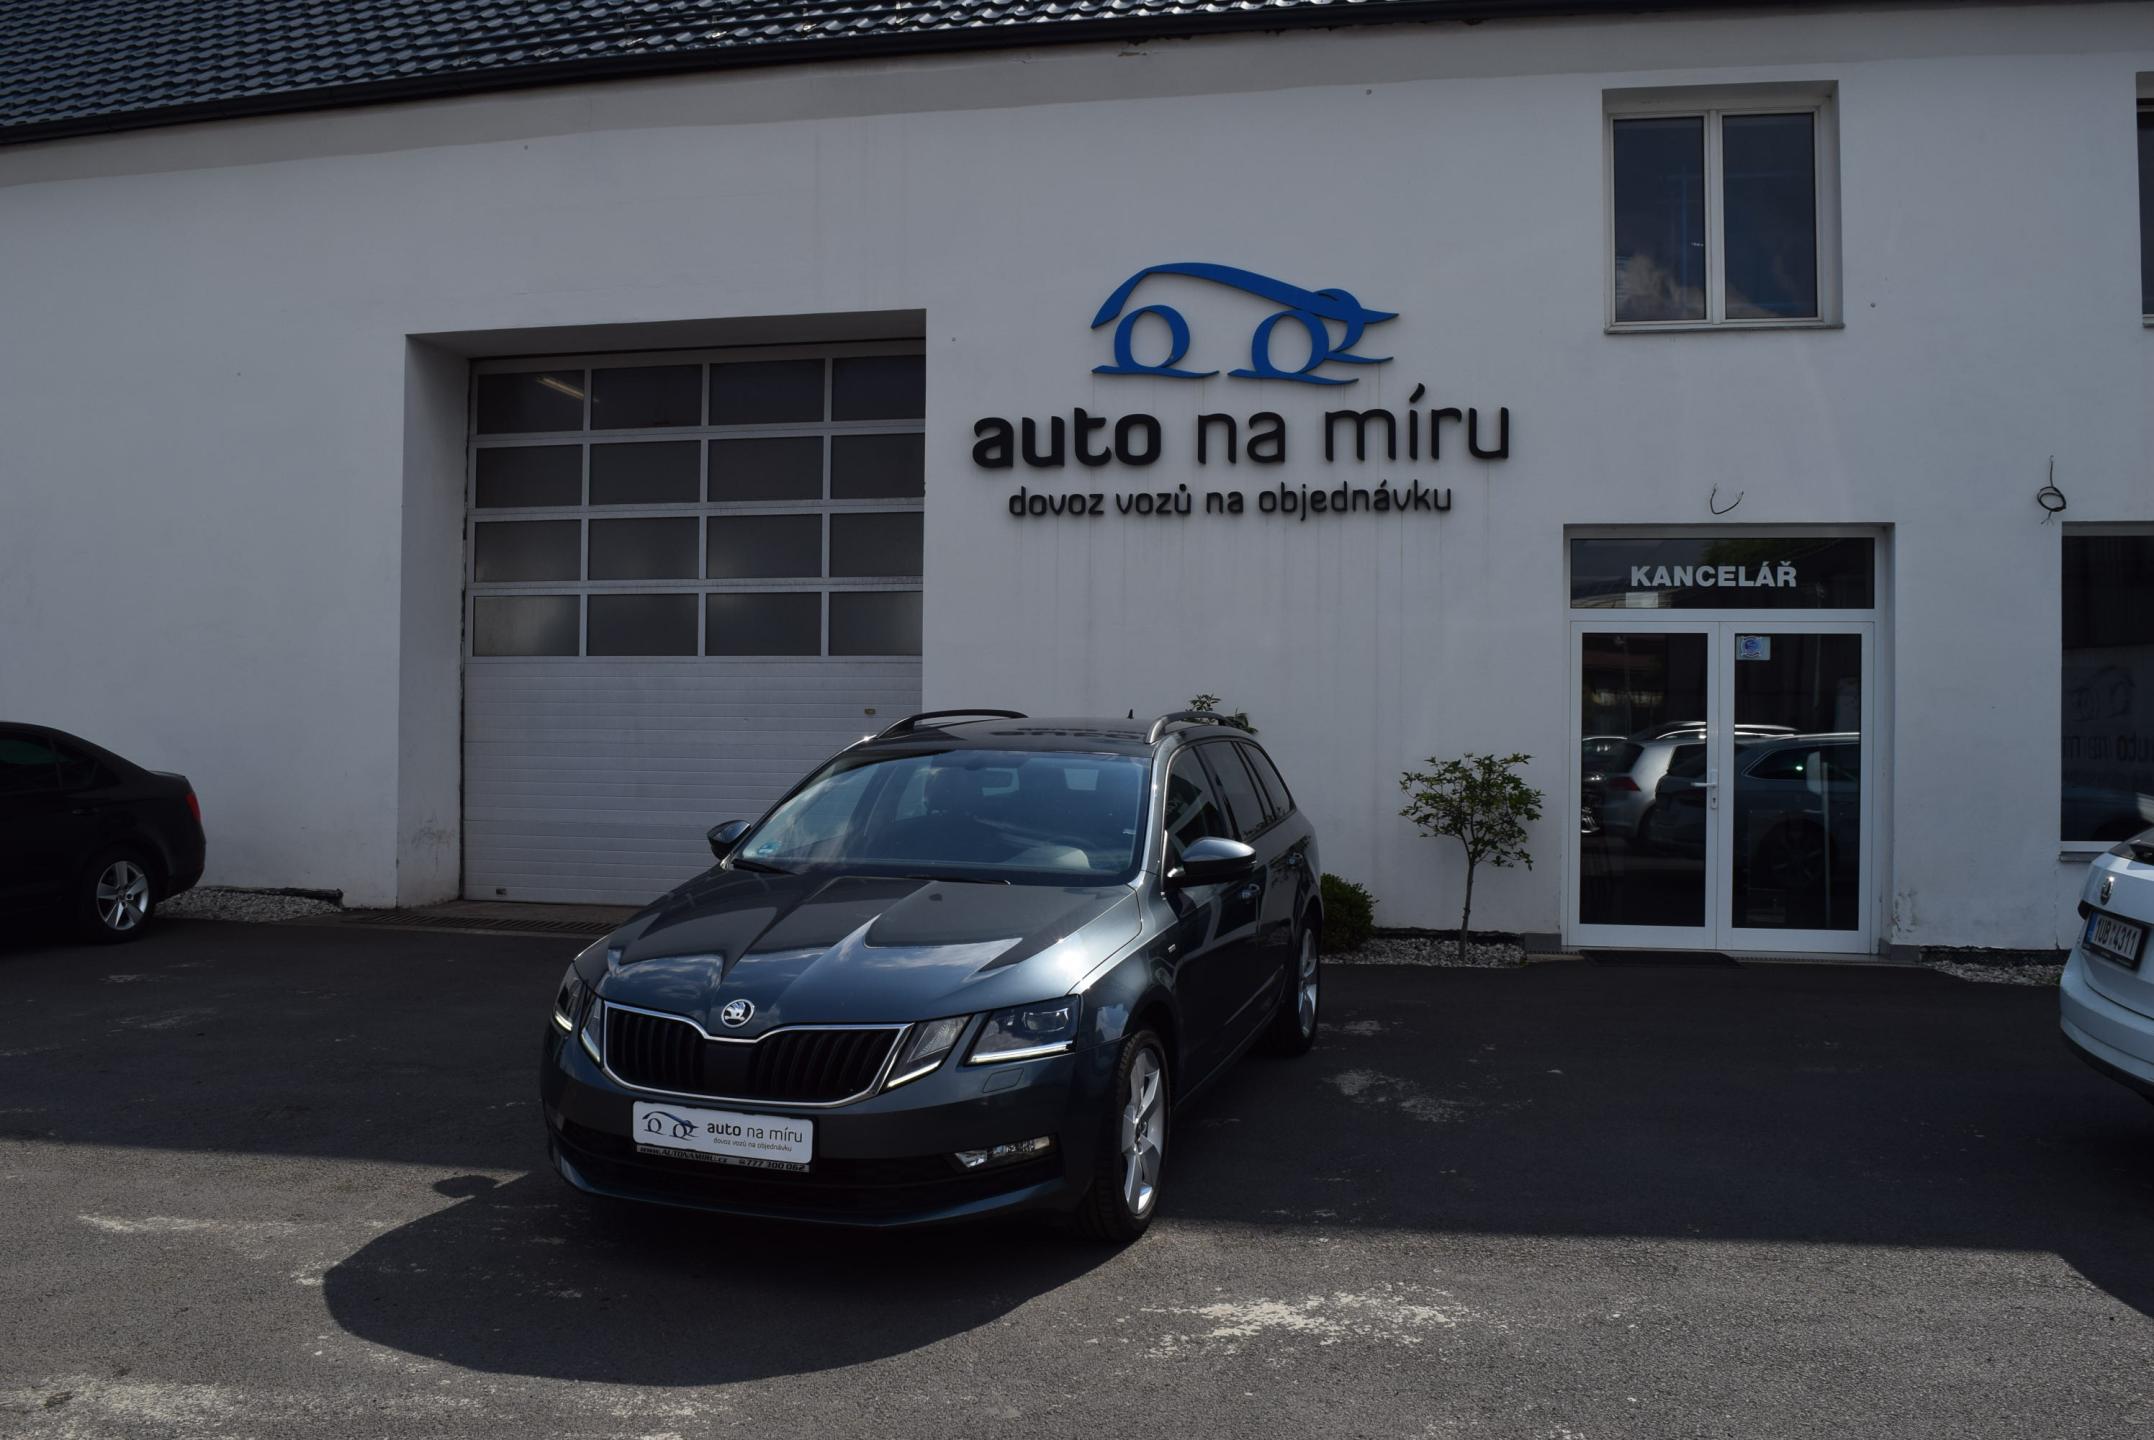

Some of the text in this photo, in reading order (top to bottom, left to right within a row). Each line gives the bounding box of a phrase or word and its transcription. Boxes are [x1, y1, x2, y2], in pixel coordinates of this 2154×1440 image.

[972, 383, 1510, 469] auto na míru
[1009, 479, 1452, 522] dovoz vozů na objednávku
[1631, 560, 1797, 587] KANCELÁŘ
[706, 1121, 803, 1143] auto na míru
[713, 1137, 731, 1145] dovoz
[757, 1142, 792, 1153] objednávku
